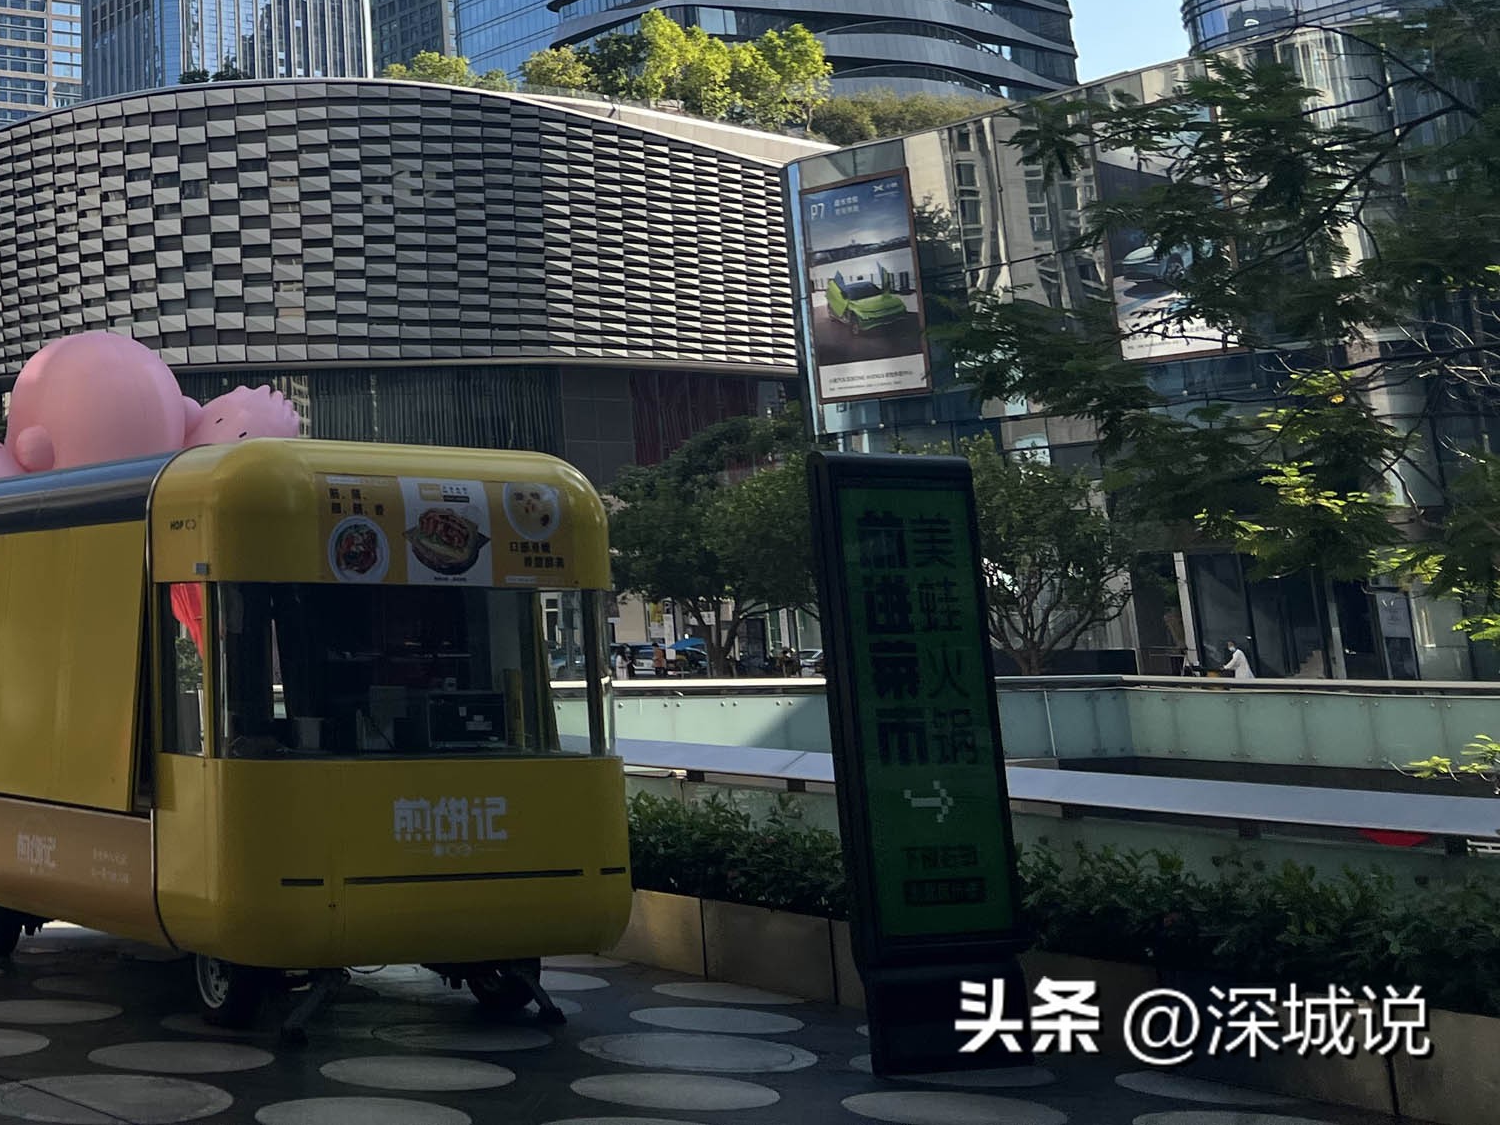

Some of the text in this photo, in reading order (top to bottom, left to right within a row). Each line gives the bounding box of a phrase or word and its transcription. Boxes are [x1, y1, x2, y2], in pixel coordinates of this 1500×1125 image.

[810, 202, 825, 220] P7
[392, 795, 508, 842] 煎饼记
